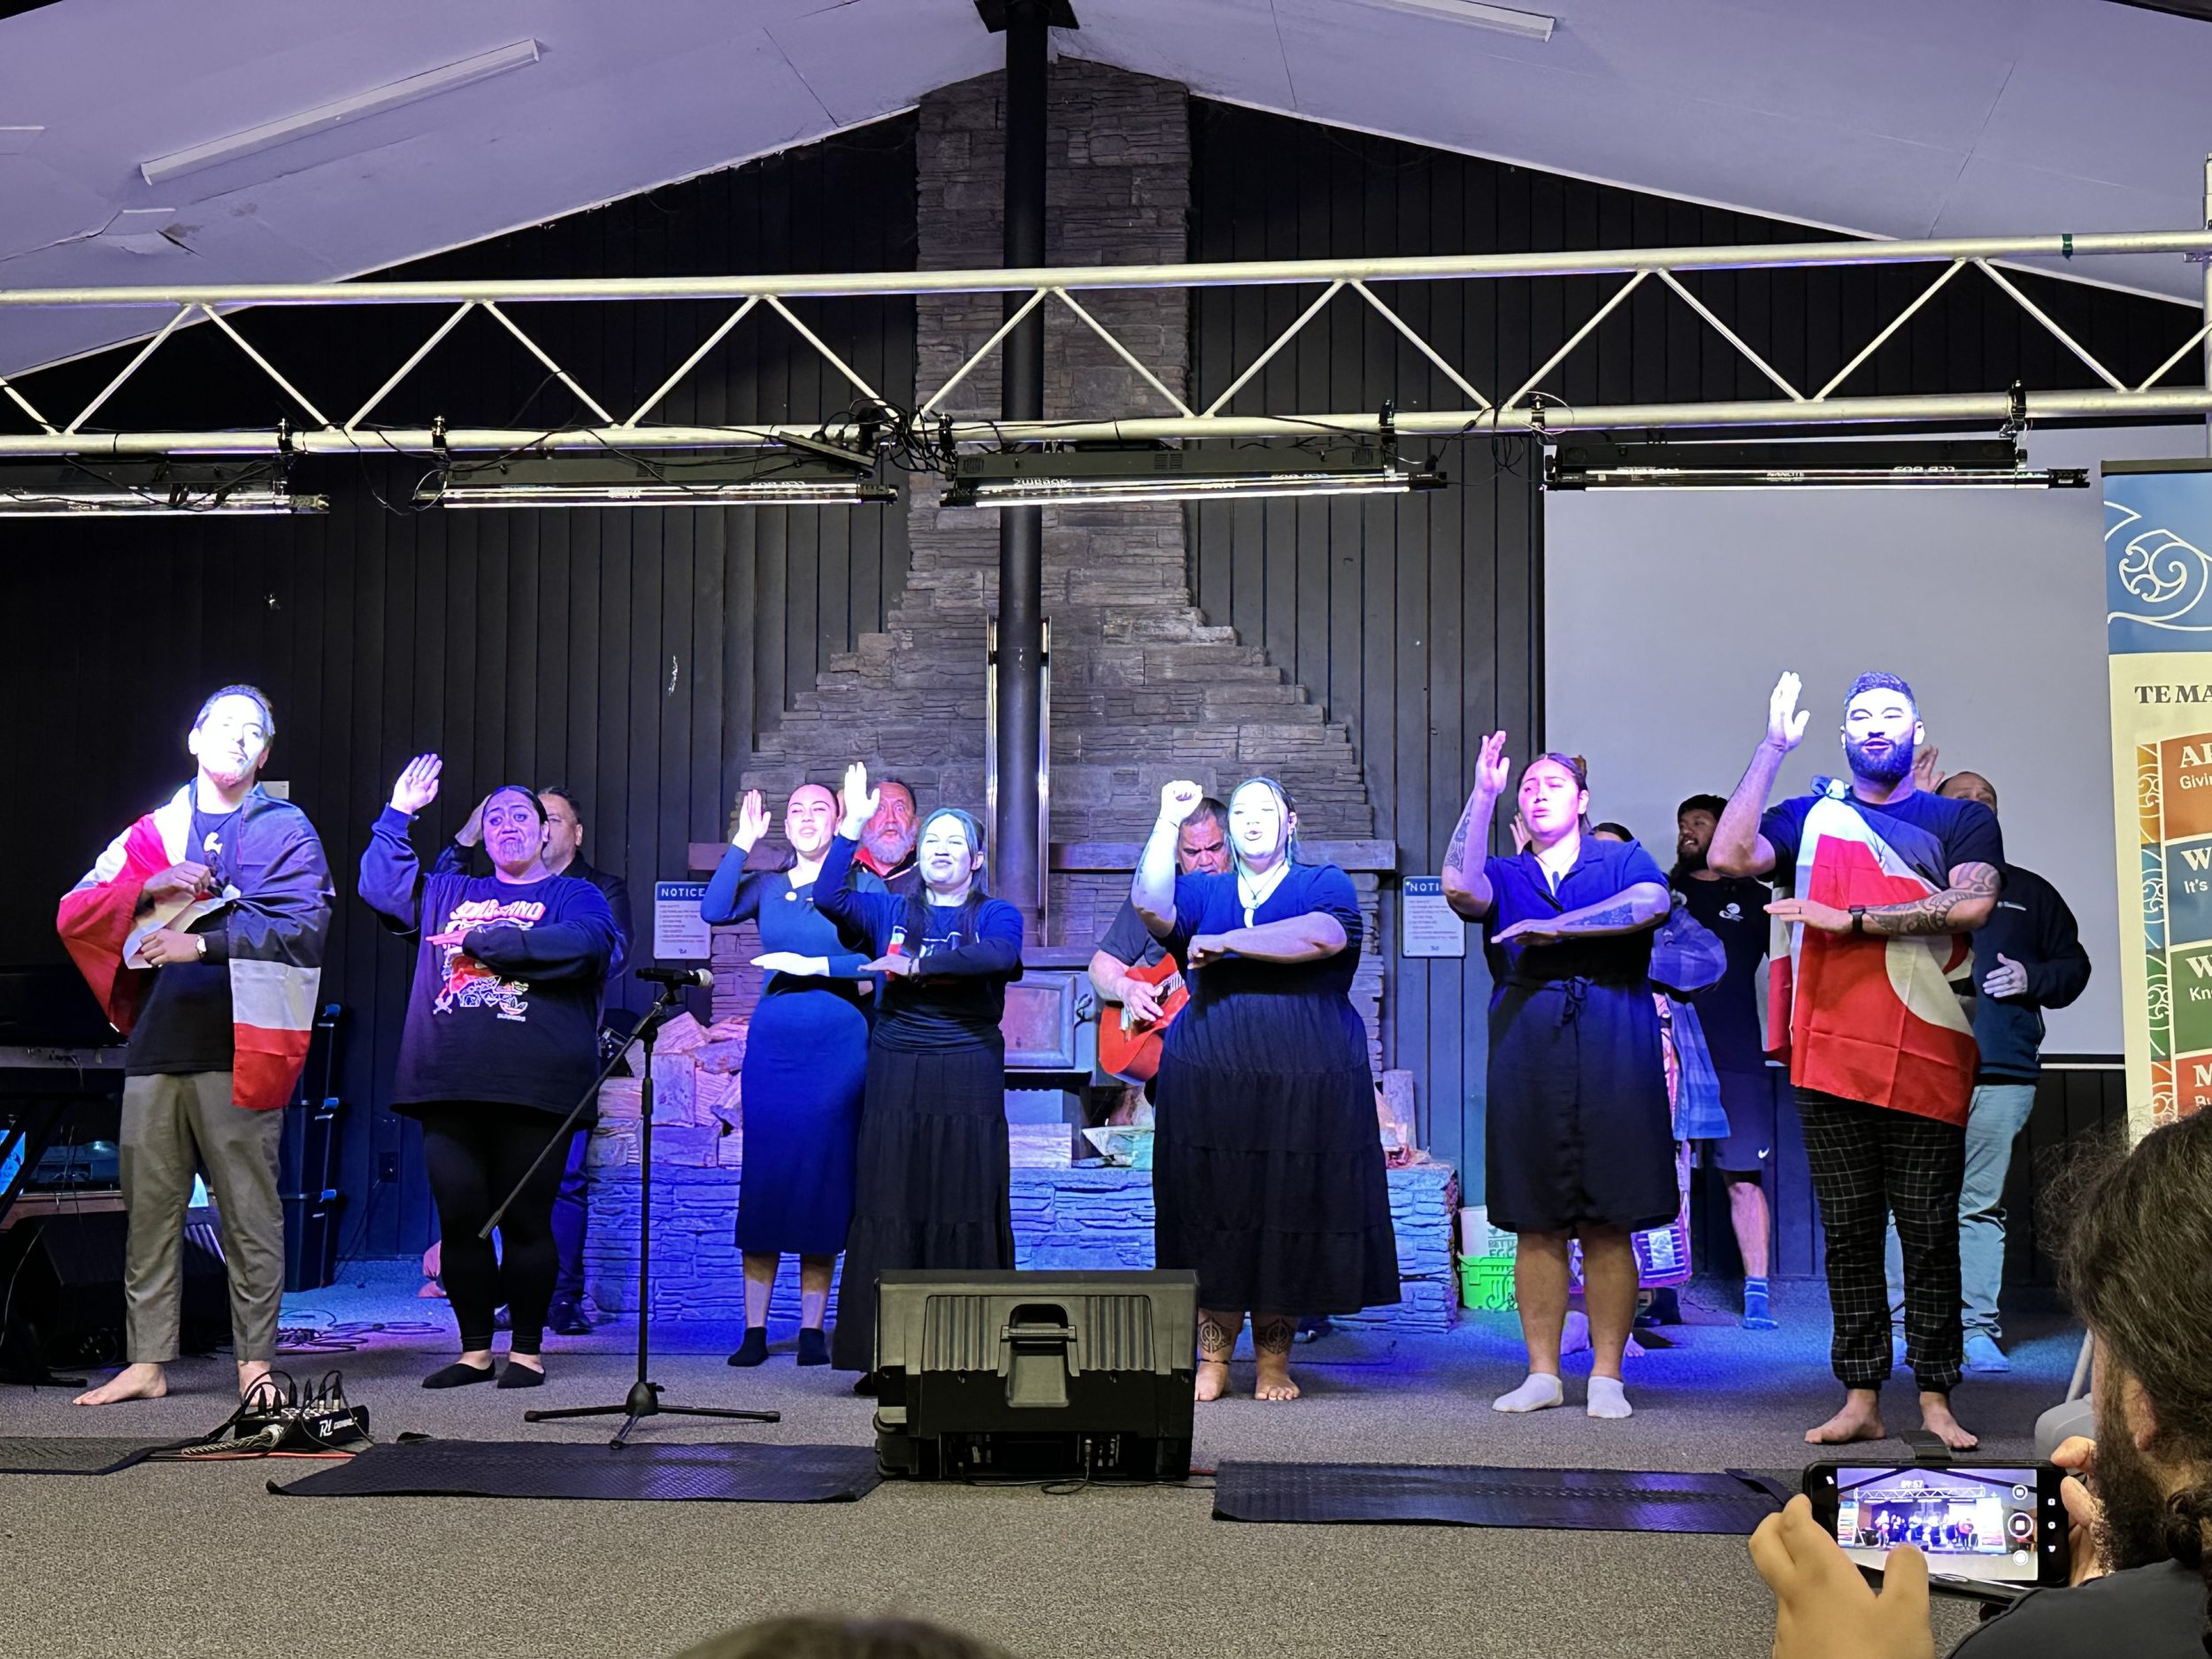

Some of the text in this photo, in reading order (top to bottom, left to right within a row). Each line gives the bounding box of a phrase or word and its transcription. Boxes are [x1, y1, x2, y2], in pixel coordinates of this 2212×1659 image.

[2134, 685, 2170, 703] TE
[661, 887, 706, 897] NOTICE
[1409, 882, 1440, 892] NOTI
[2184, 879, 2208, 894] It's
[2189, 987, 2212, 1002] Kn
